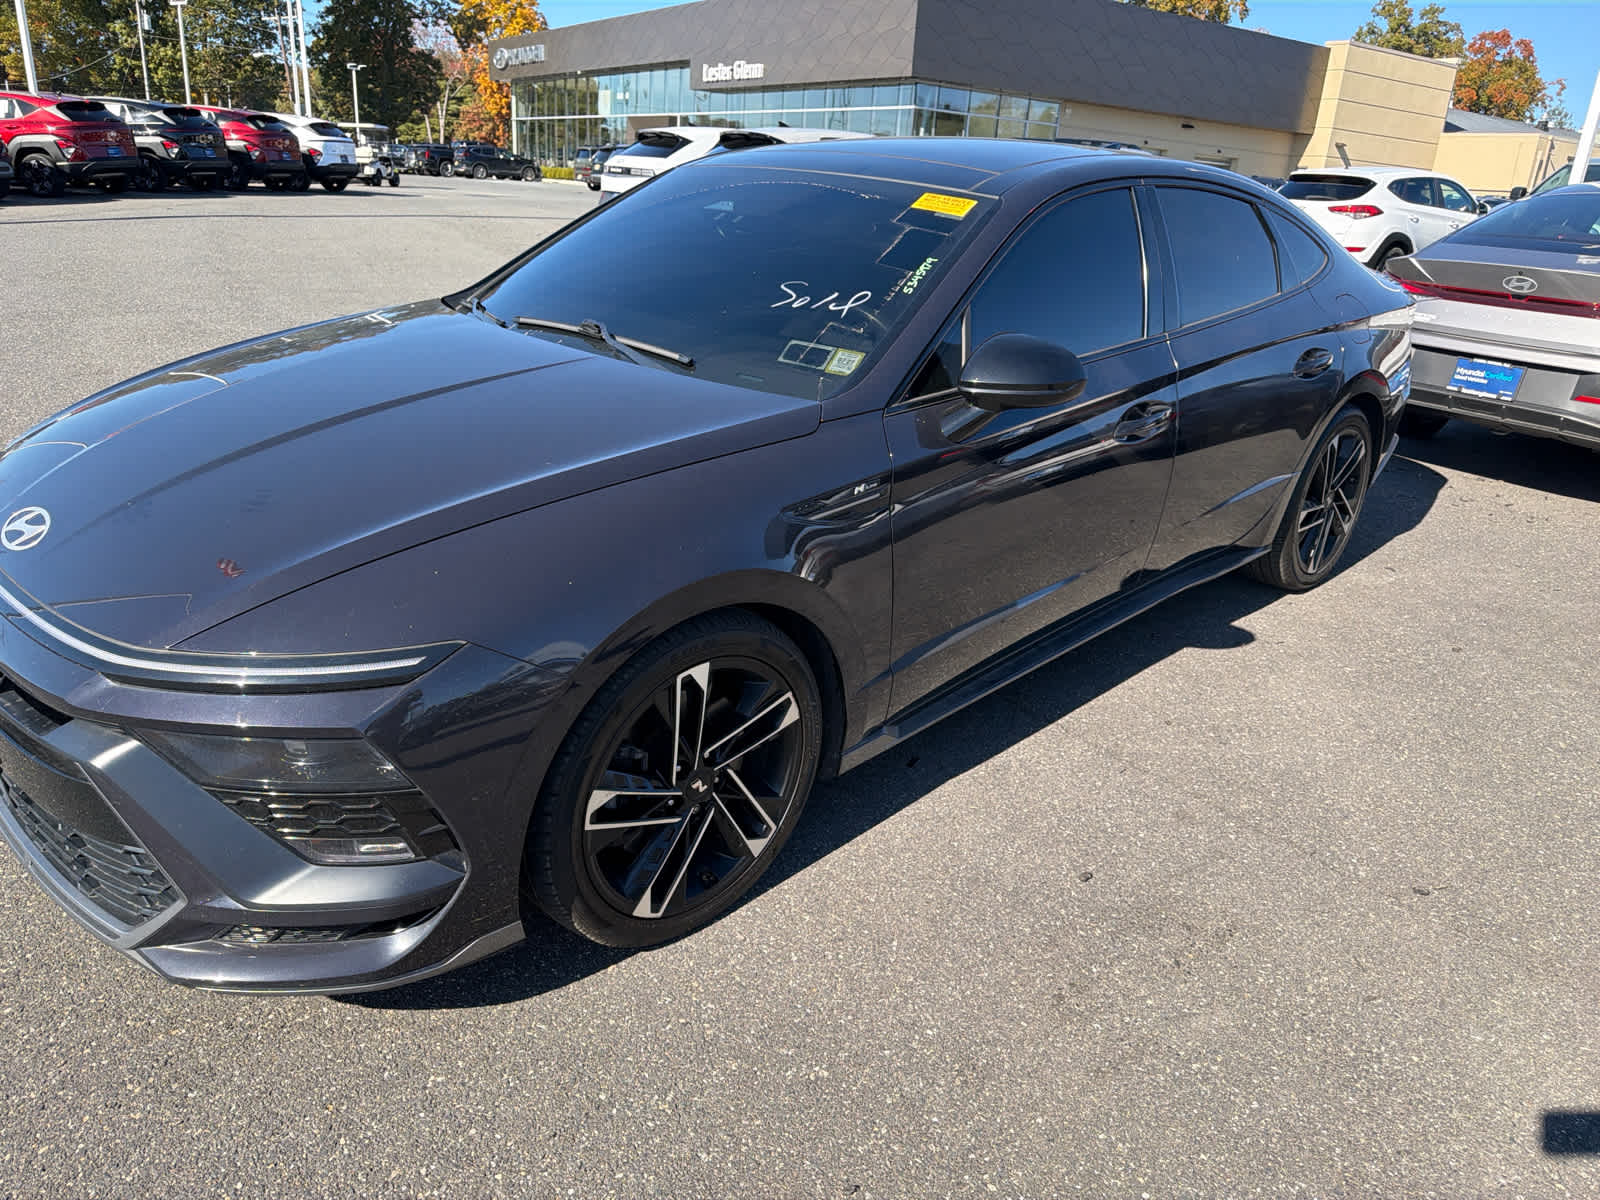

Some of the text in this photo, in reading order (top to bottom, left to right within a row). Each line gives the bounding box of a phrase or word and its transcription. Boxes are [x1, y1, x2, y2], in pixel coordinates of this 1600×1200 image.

[702, 60, 764, 82] Lester Glenn
[770, 280, 872, 318] Sold
